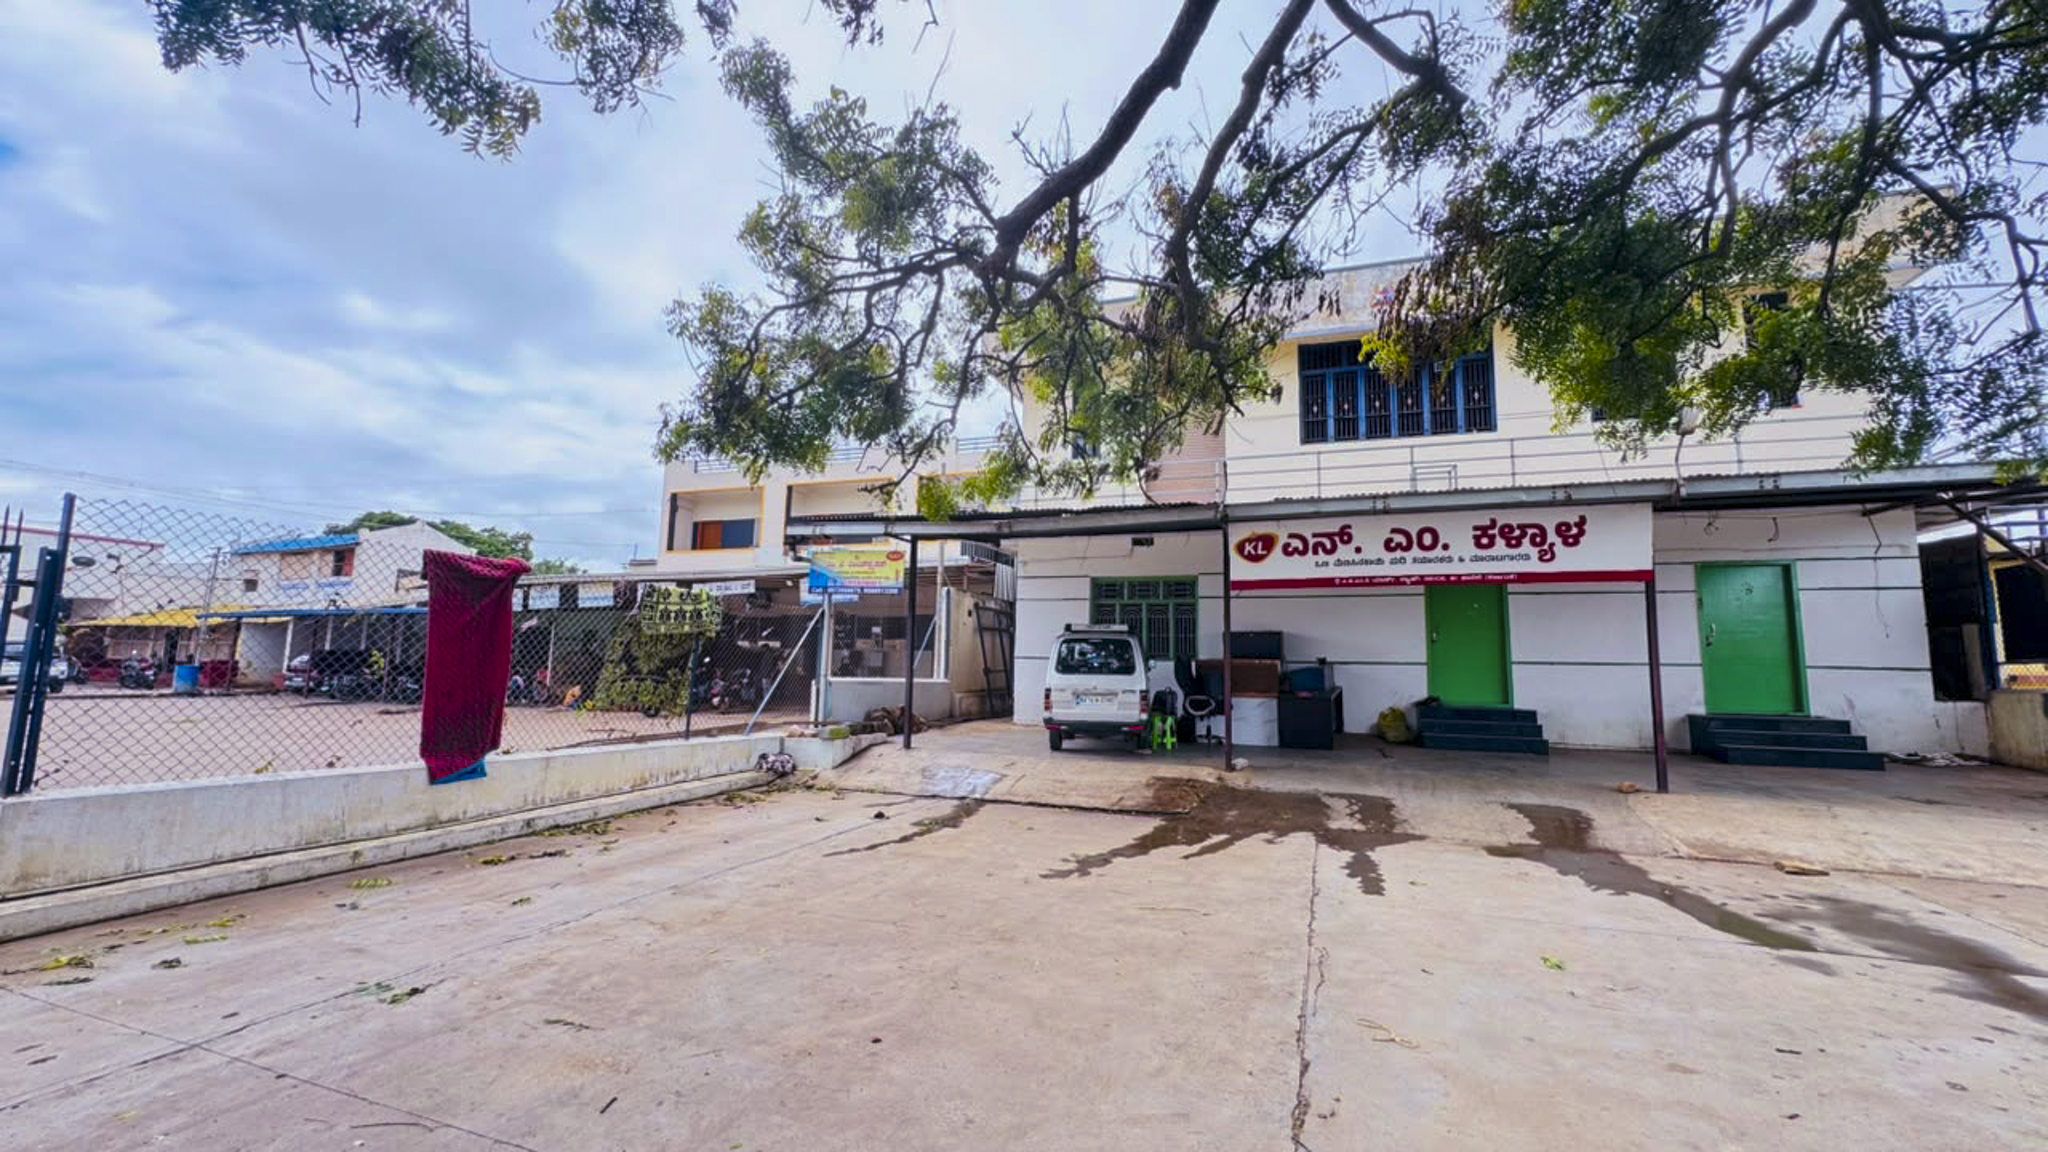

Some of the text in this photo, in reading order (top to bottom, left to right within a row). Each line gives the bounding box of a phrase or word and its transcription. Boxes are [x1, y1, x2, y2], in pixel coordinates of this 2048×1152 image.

[1243, 540, 1269, 557] KL
[1281, 514, 1588, 563] ಎನ್. ಎಂ. ಕಳ್ಯಾಳ
